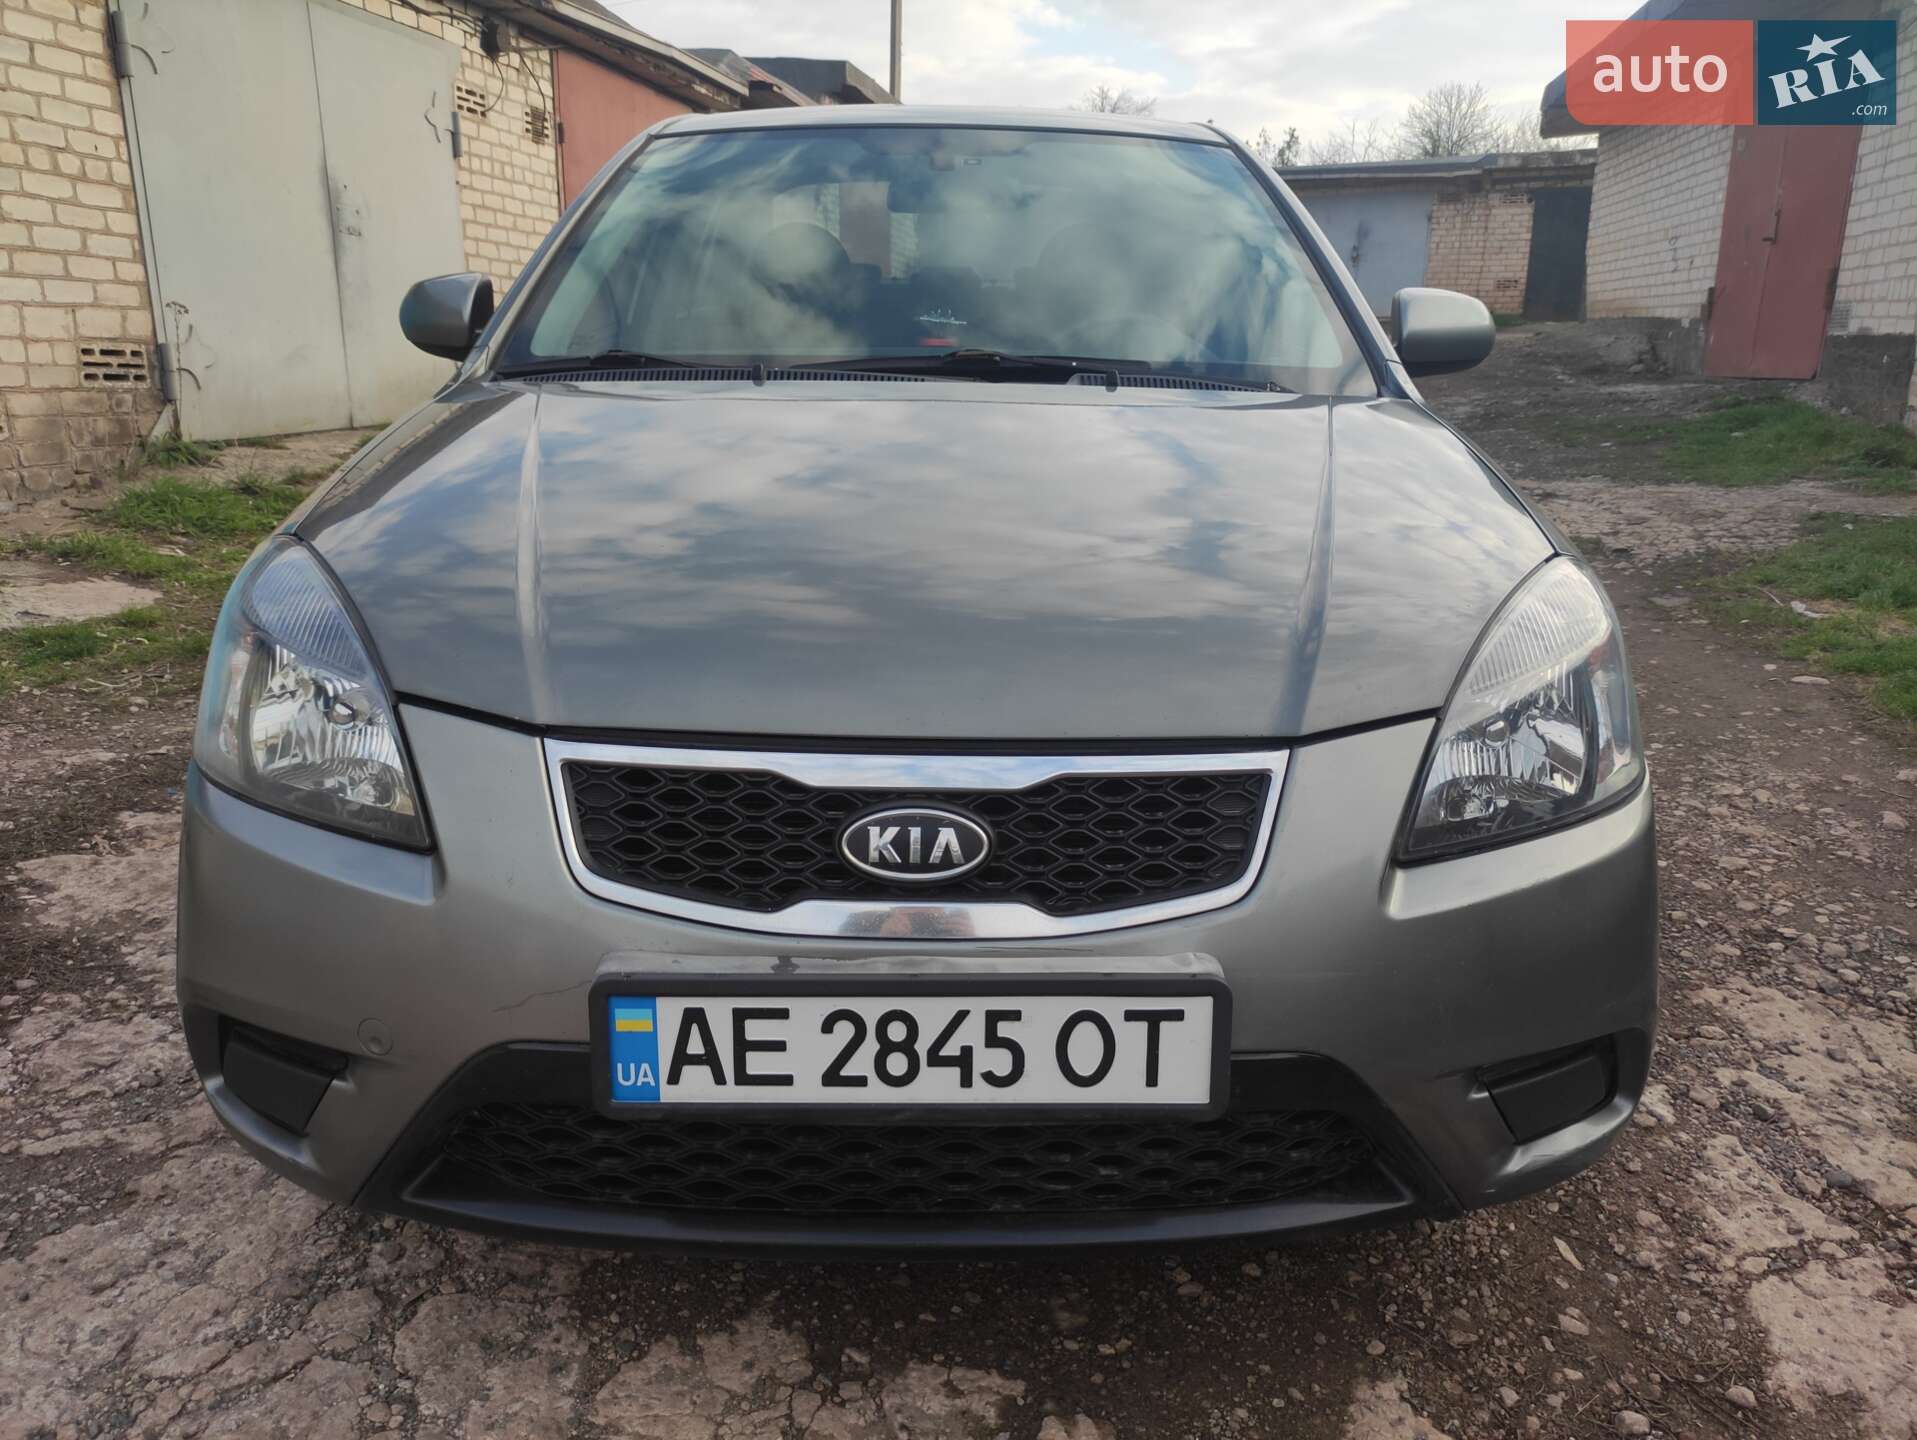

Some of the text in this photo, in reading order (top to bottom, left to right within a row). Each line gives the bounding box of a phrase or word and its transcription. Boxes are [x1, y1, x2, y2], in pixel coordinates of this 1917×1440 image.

[867, 826, 965, 864] KIA
[666, 1007, 1185, 1089] AE 2845 OT
[617, 1063, 656, 1086] UA
